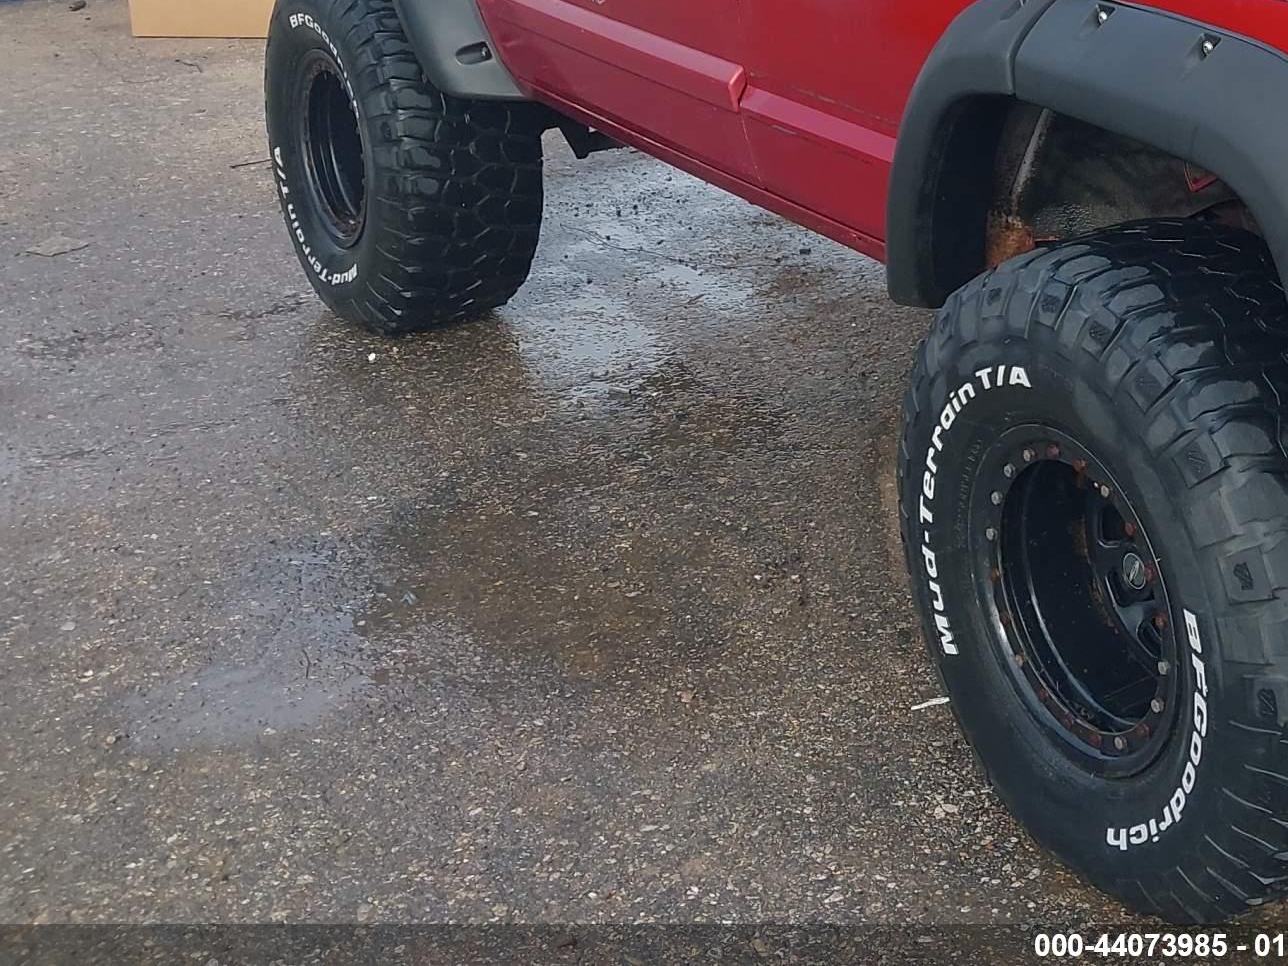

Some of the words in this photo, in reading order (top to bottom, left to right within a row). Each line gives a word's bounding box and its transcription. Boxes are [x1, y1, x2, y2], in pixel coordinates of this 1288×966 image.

[919, 381, 977, 657] Mud-Terrain
[975, 364, 1032, 390] T/A
[1105, 608, 1208, 852] BFGoodrich
